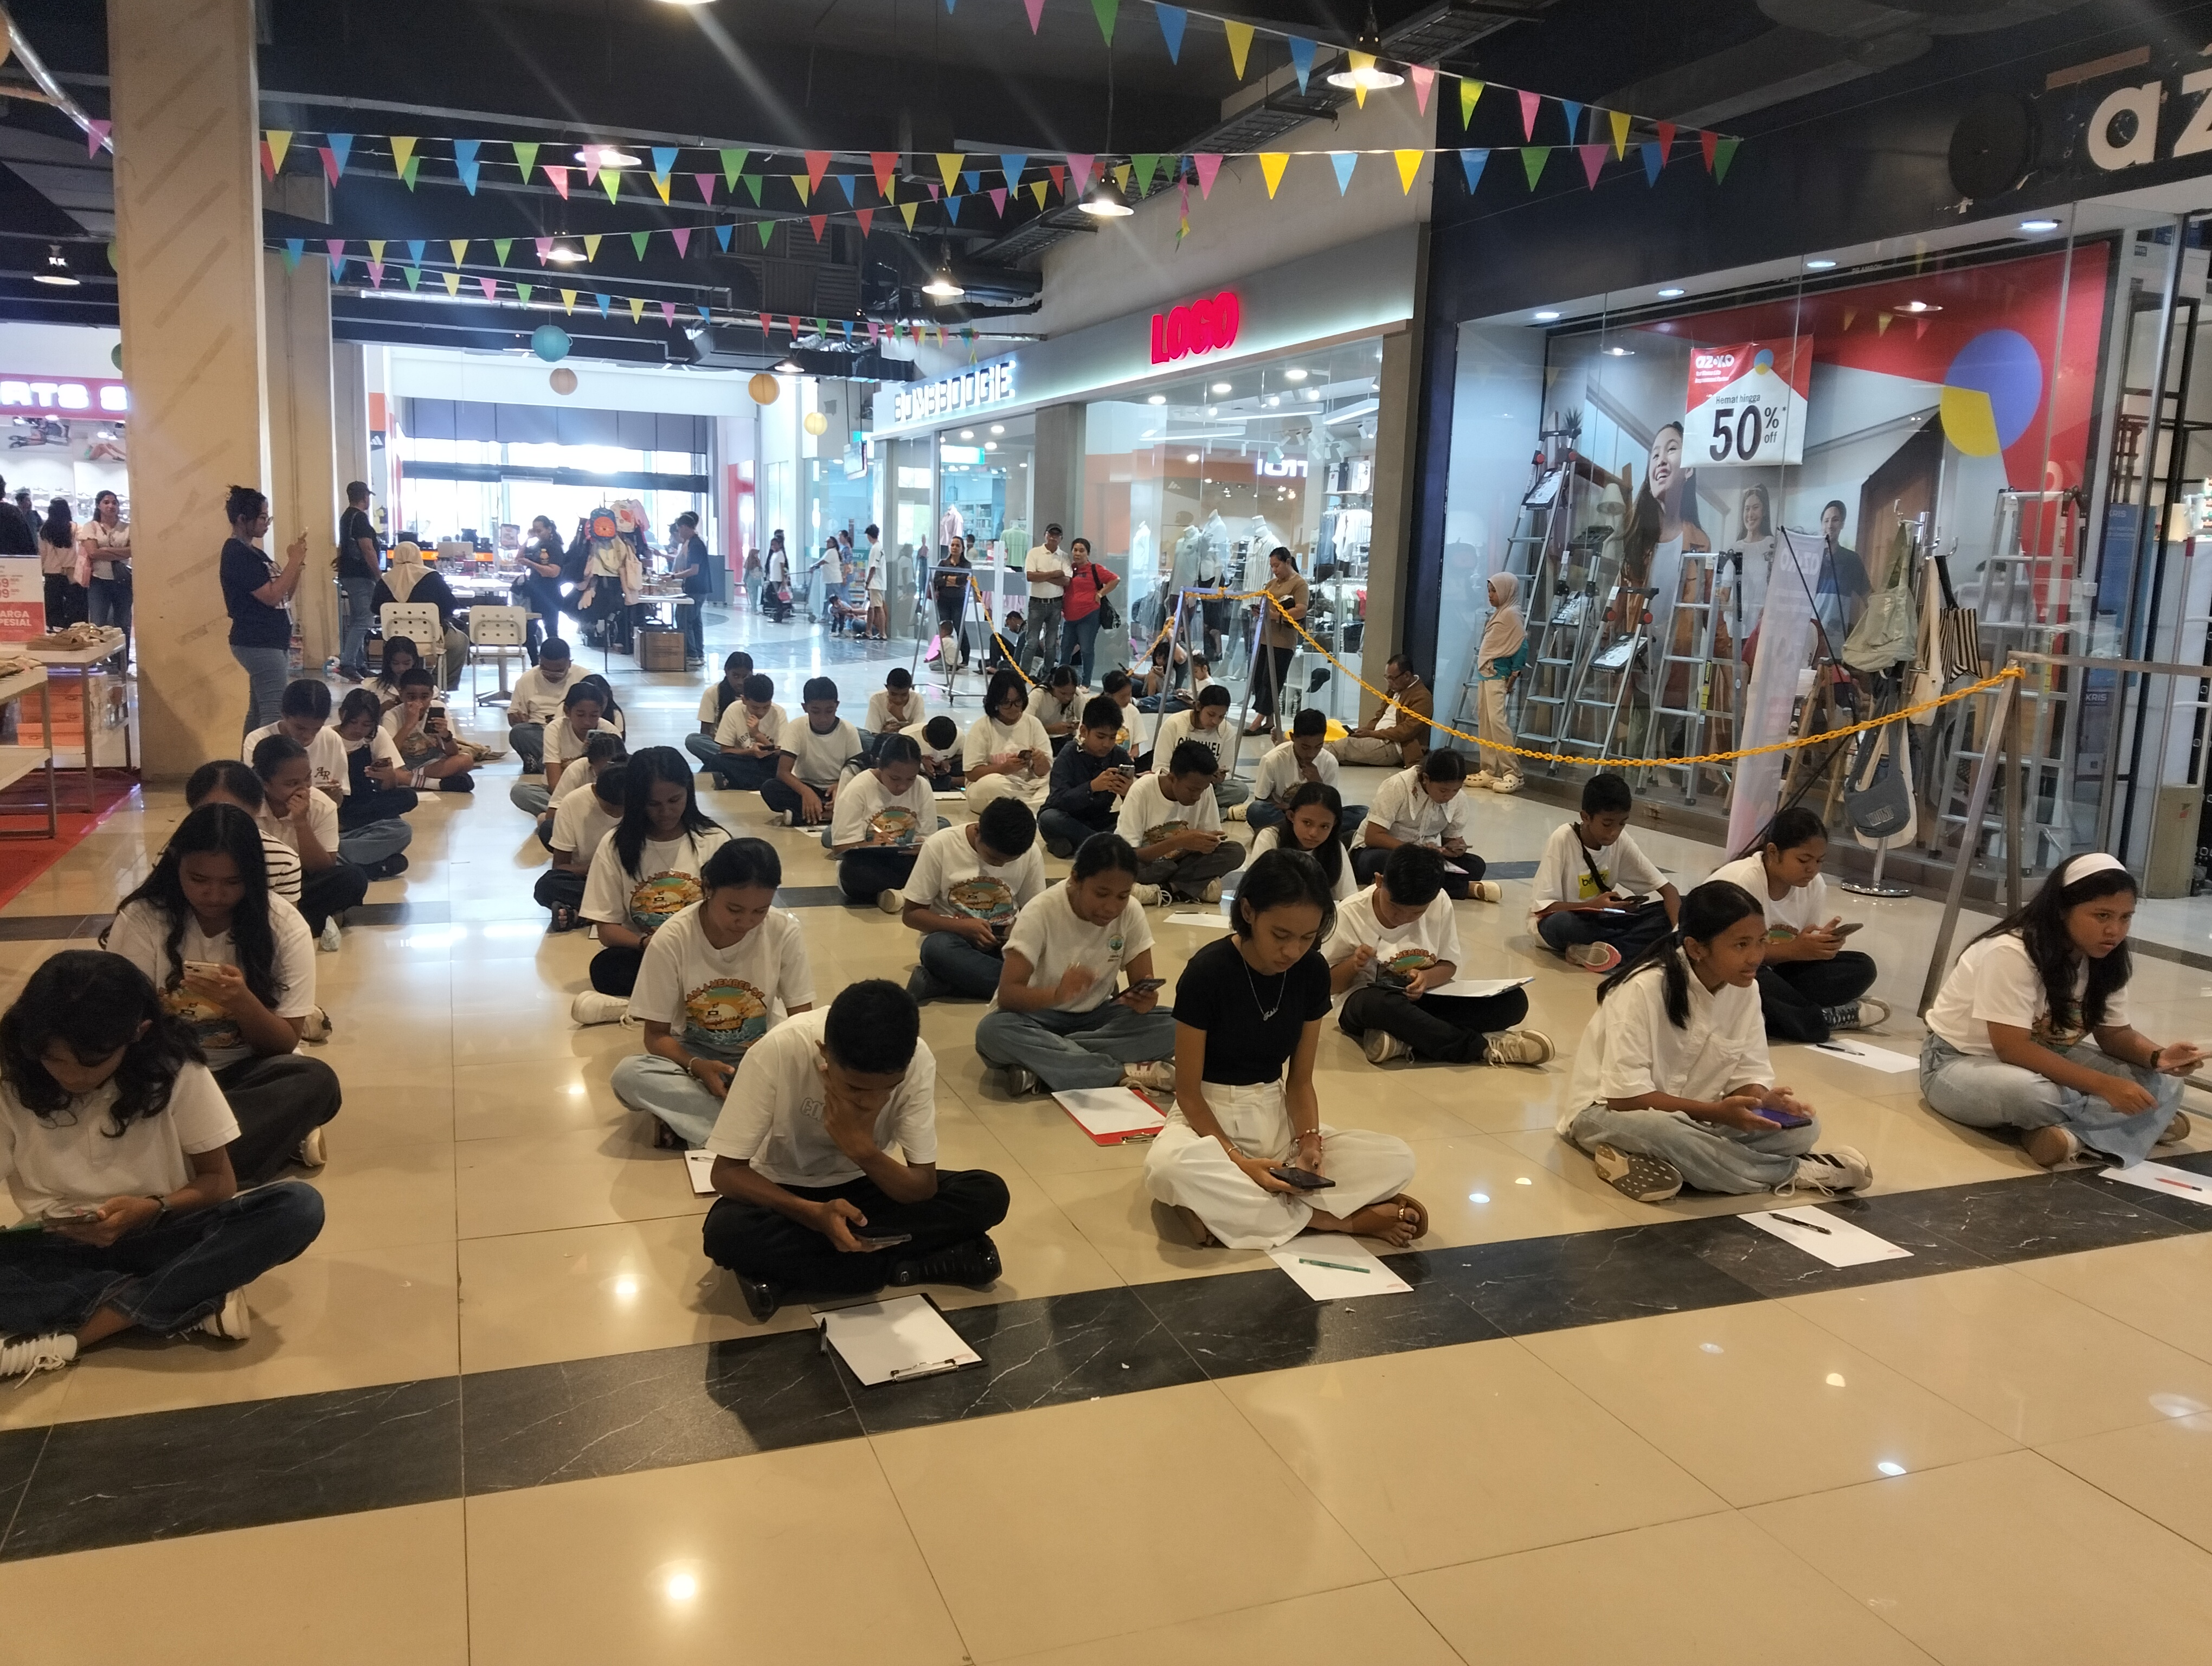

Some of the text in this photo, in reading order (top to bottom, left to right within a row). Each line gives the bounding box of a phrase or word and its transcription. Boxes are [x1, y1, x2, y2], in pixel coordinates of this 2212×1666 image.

[1152, 291, 1239, 365] LOGO
[1716, 394, 1760, 404] Hemat hingga
[1764, 431, 1777, 444] off
[710, 978, 751, 992] MEMBER
